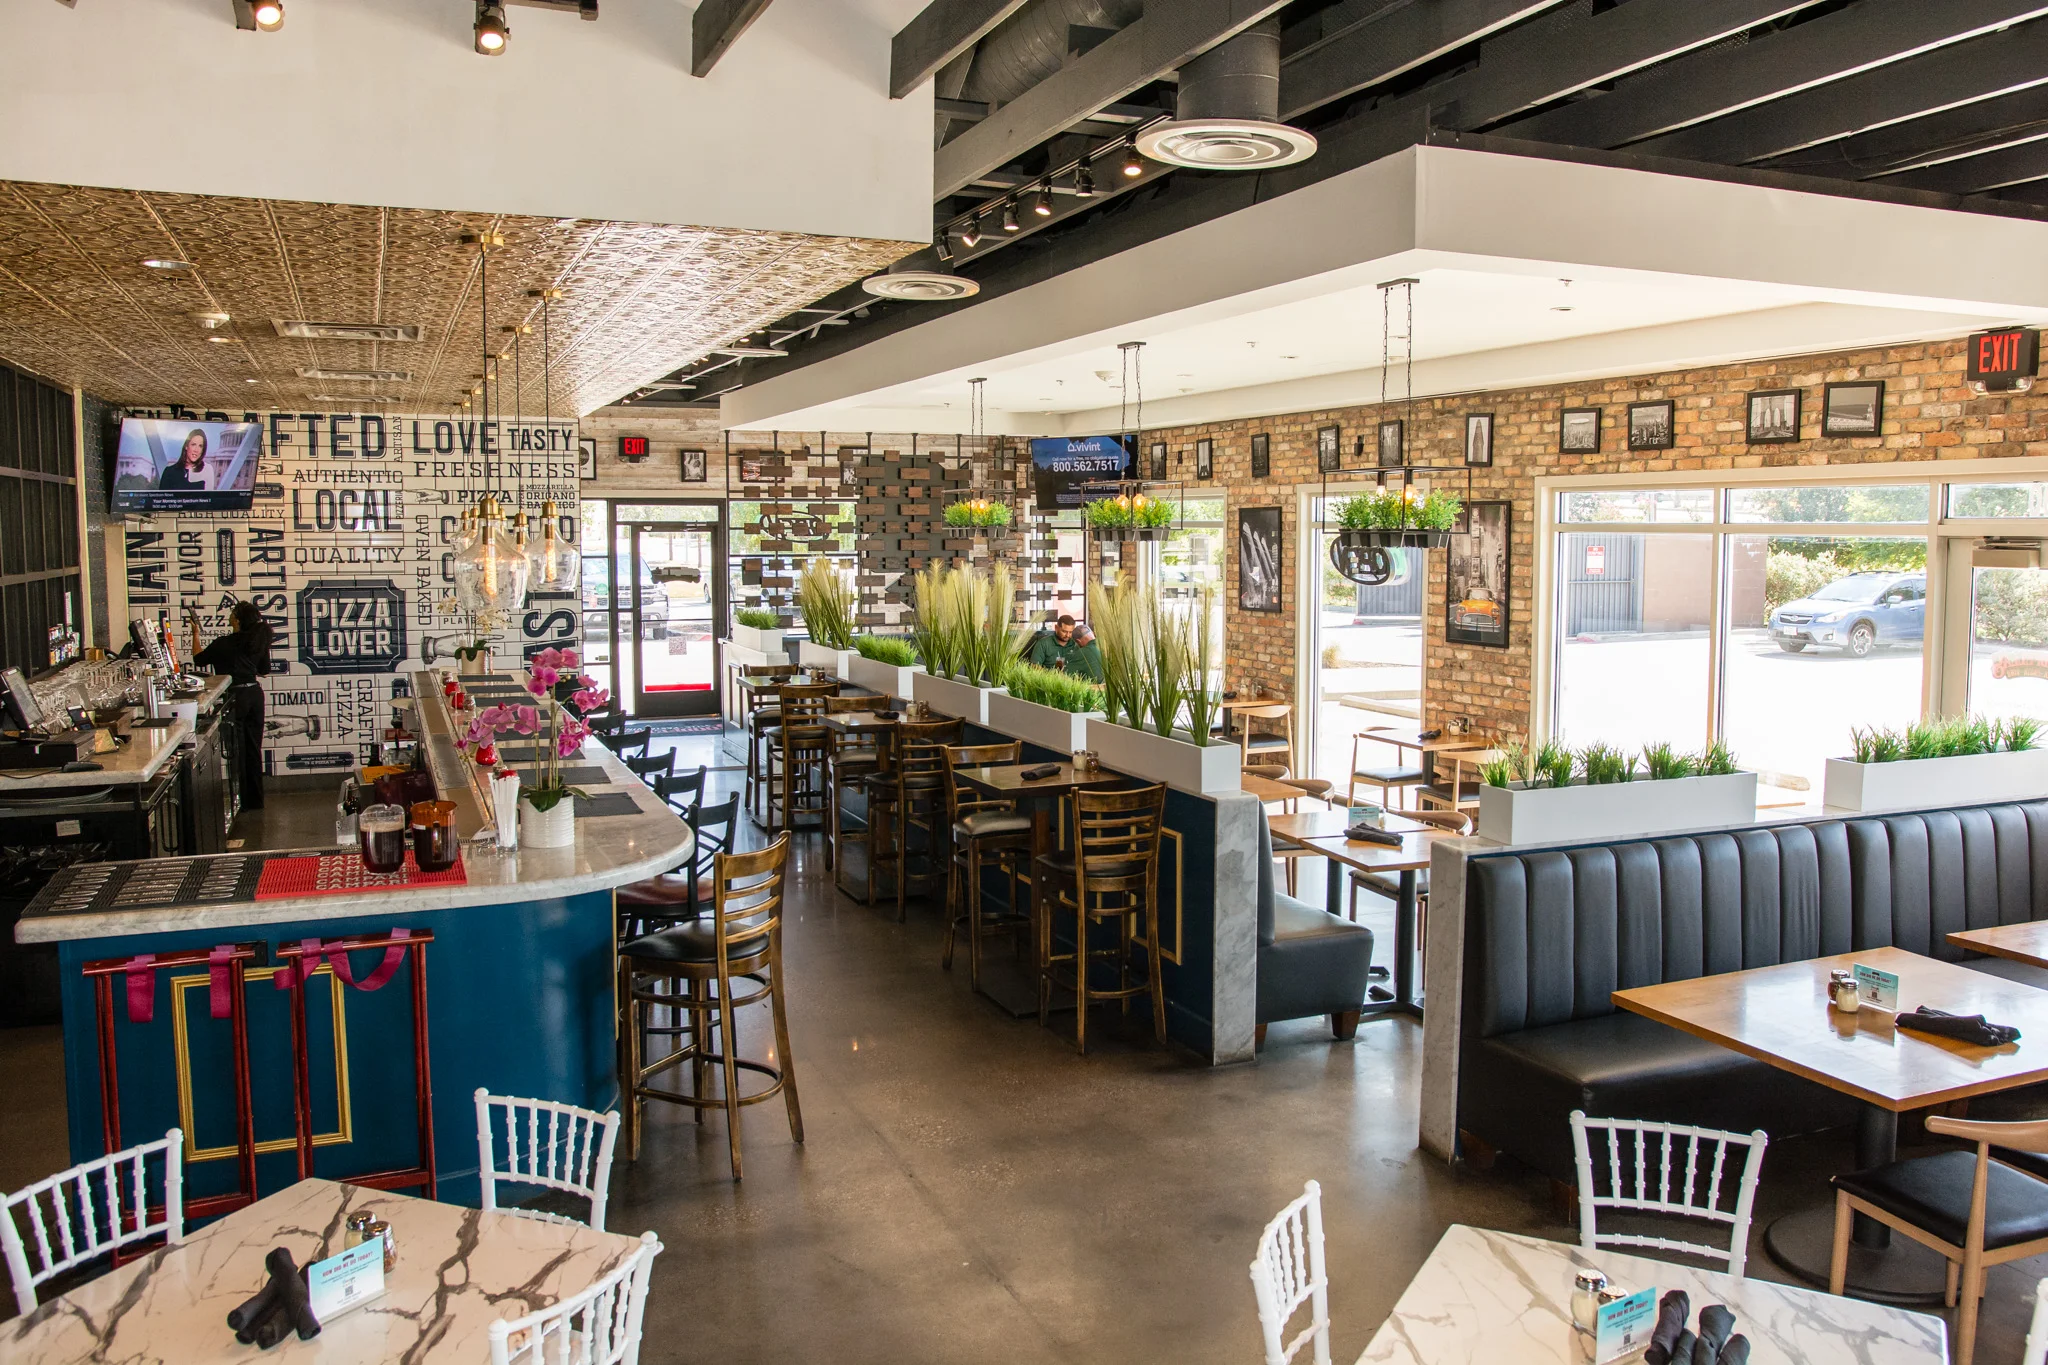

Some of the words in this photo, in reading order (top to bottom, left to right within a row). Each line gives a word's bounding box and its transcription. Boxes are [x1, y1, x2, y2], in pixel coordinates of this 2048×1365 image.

[1978, 333, 2022, 373] EXIT
[393, 416, 403, 463] ARTISAN
[413, 421, 498, 455] LOVE
[507, 429, 573, 451] TASTY
[624, 438, 646, 455] EXIT
[292, 470, 403, 483] AUTHENTIC
[413, 462, 575, 478] FRESHNESS
[1052, 460, 1120, 472] 800.562.7517
[526, 491, 576, 500] ORIGANO
[222, 509, 285, 520] QUALITY
[293, 489, 404, 532] LOCAL
[416, 515, 431, 562] OVEN
[178, 531, 204, 610] FLAVOR
[295, 548, 405, 566] QUALITY
[417, 566, 432, 626] BAKED
[311, 598, 392, 629] PIZZA
[151, 642, 165, 669] EIGHT
[312, 629, 393, 657] LOVER
[270, 691, 324, 706] TOMATO
[336, 680, 353, 739] PIZZA
[357, 679, 375, 766] CRAFTED
[316, 879, 408, 890] CAMPARI
